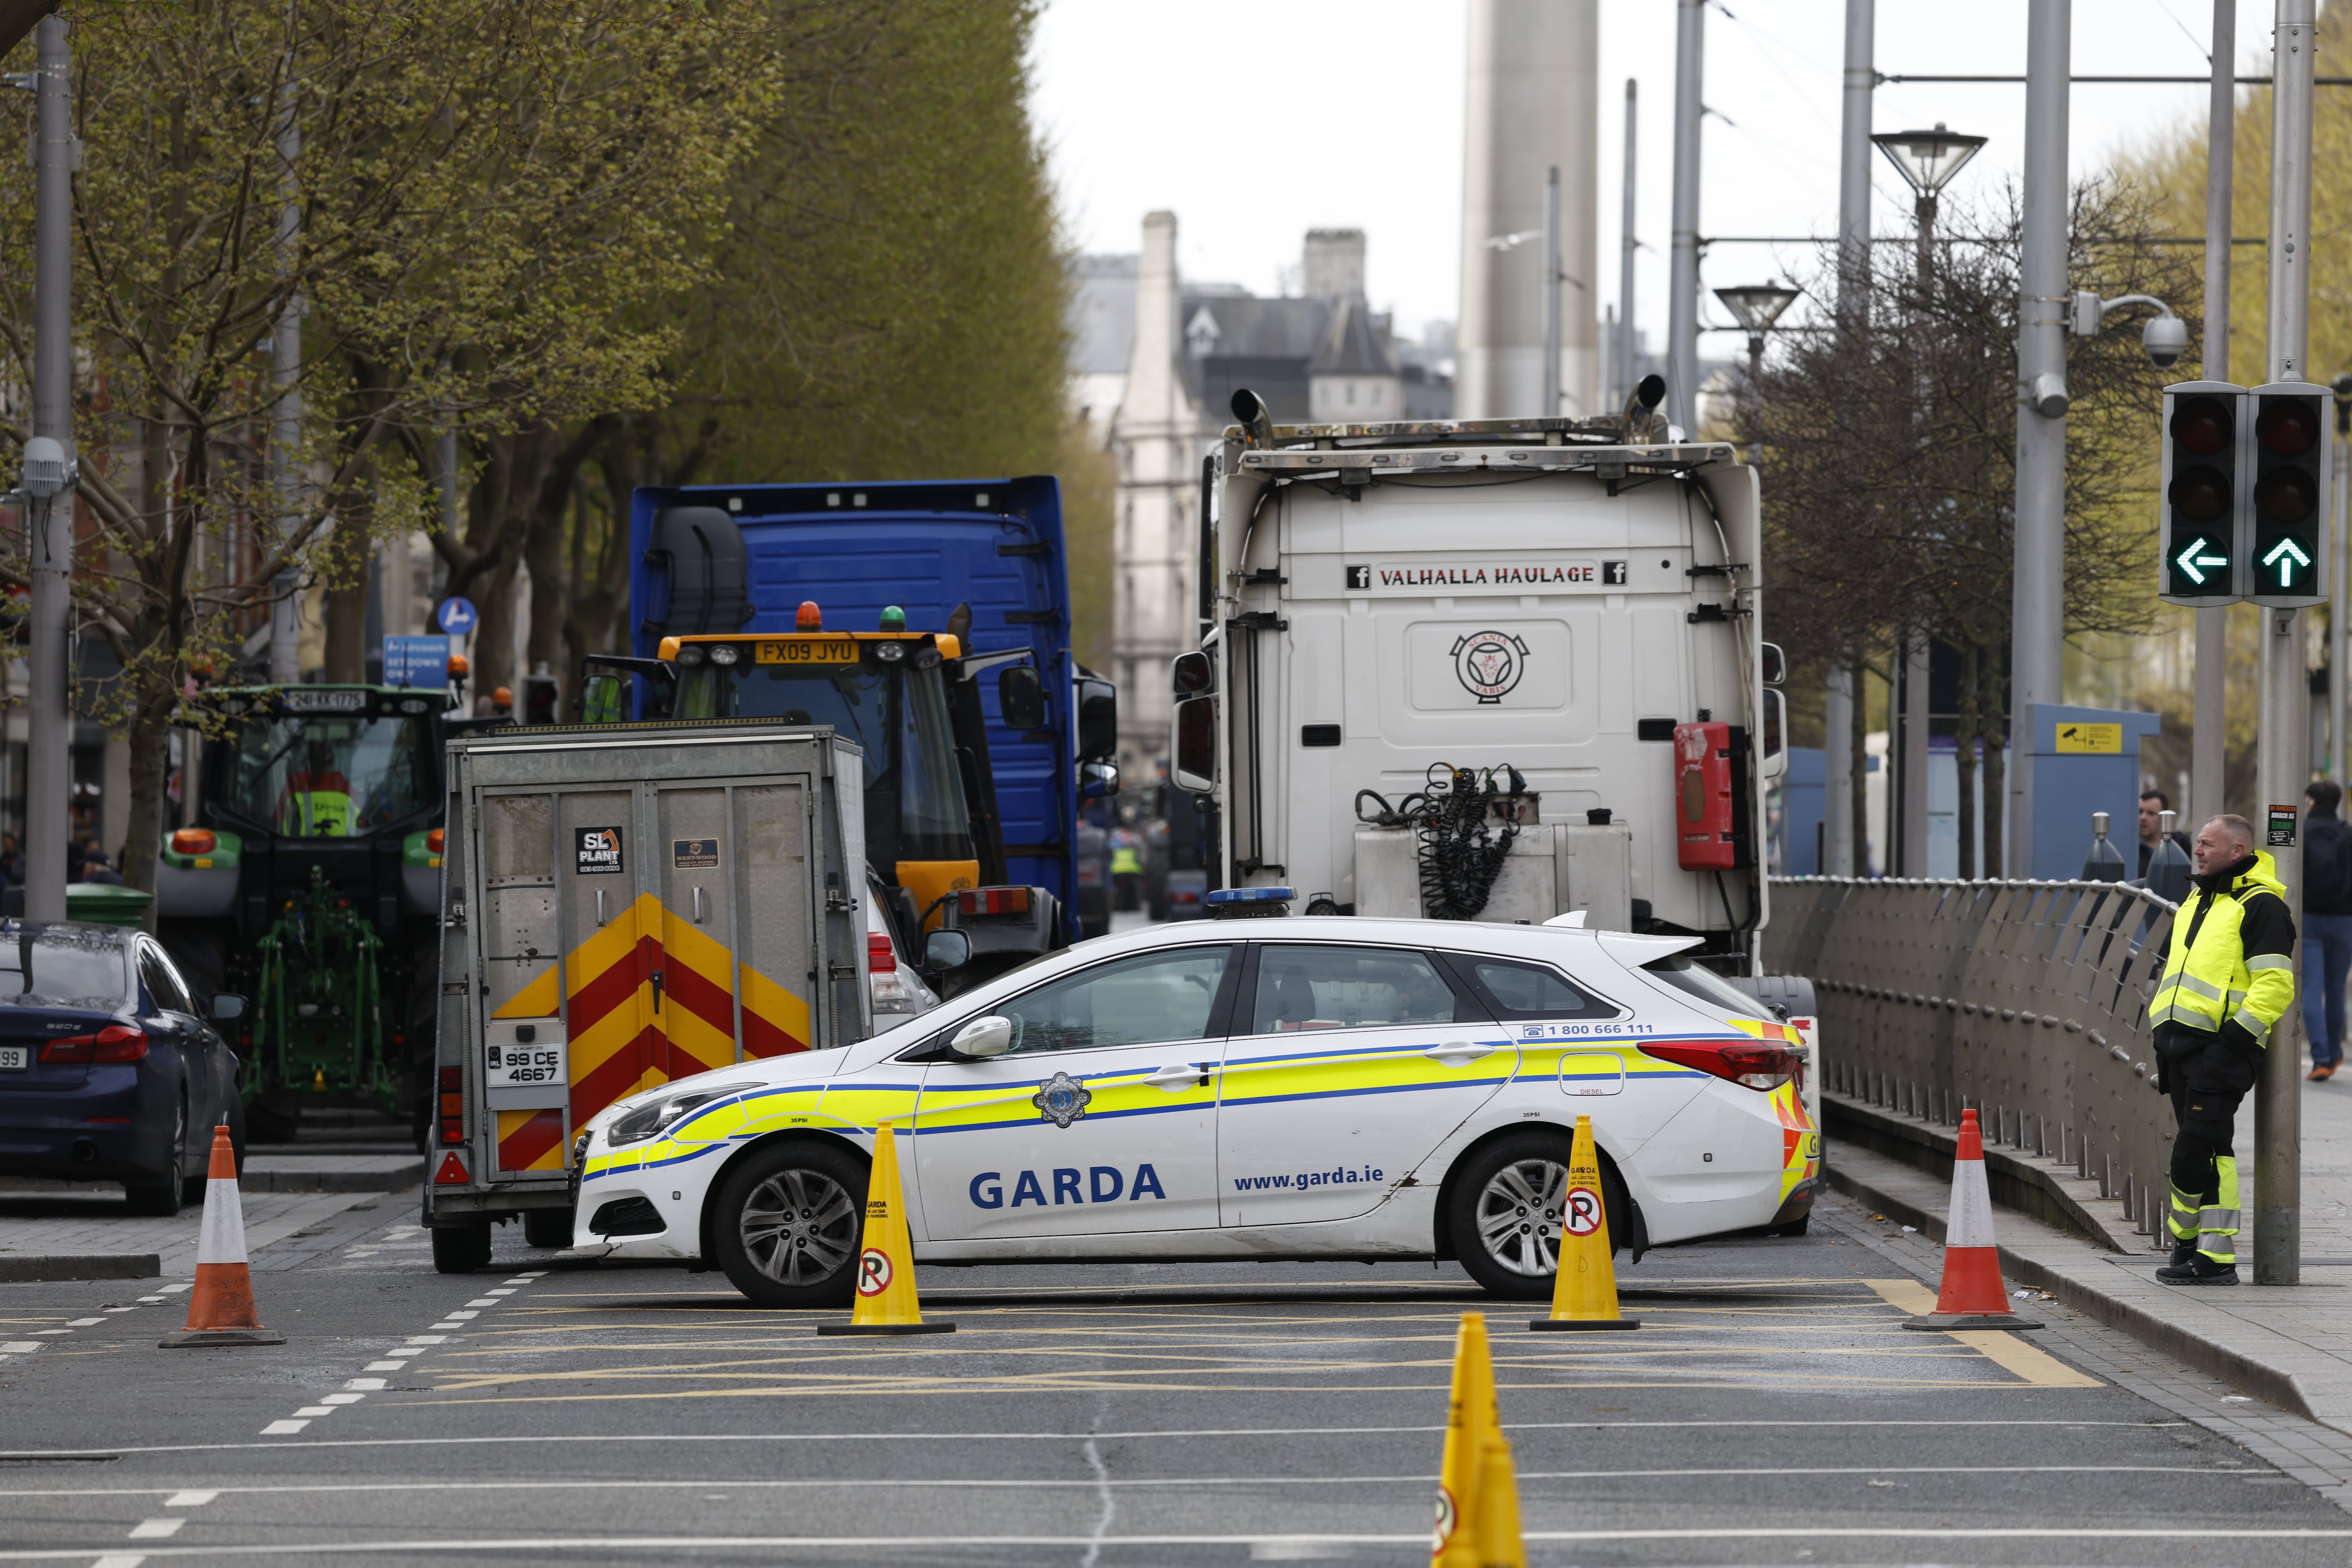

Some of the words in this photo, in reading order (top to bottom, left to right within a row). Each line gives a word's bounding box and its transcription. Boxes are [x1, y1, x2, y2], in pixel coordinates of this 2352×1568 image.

[1379, 569, 1487, 586] VALHALLA
[1494, 567, 1594, 583] HAULAGE
[1468, 634, 1507, 649] SCANIA
[764, 644, 810, 660] FX09
[817, 644, 851, 660] JYU
[387, 669, 415, 678] ONY
[1476, 685, 1506, 694] VABIS
[584, 833, 609, 850] SL
[579, 850, 620, 862] PLANT
[1549, 1027, 1556, 1035] 1
[1562, 1026, 1589, 1035] 800
[1595, 1025, 1621, 1034] 666
[1627, 1025, 1653, 1033] 111
[0, 1051, 19, 1066] 99
[506, 1053, 530, 1066] 99
[534, 1051, 558, 1065] CE
[509, 1067, 556, 1081] 4667
[1234, 1165, 1383, 1191] www.garda.ie
[969, 1163, 1166, 1209] GARDA
[1571, 1197, 1592, 1227] P
[861, 1257, 882, 1287] P
